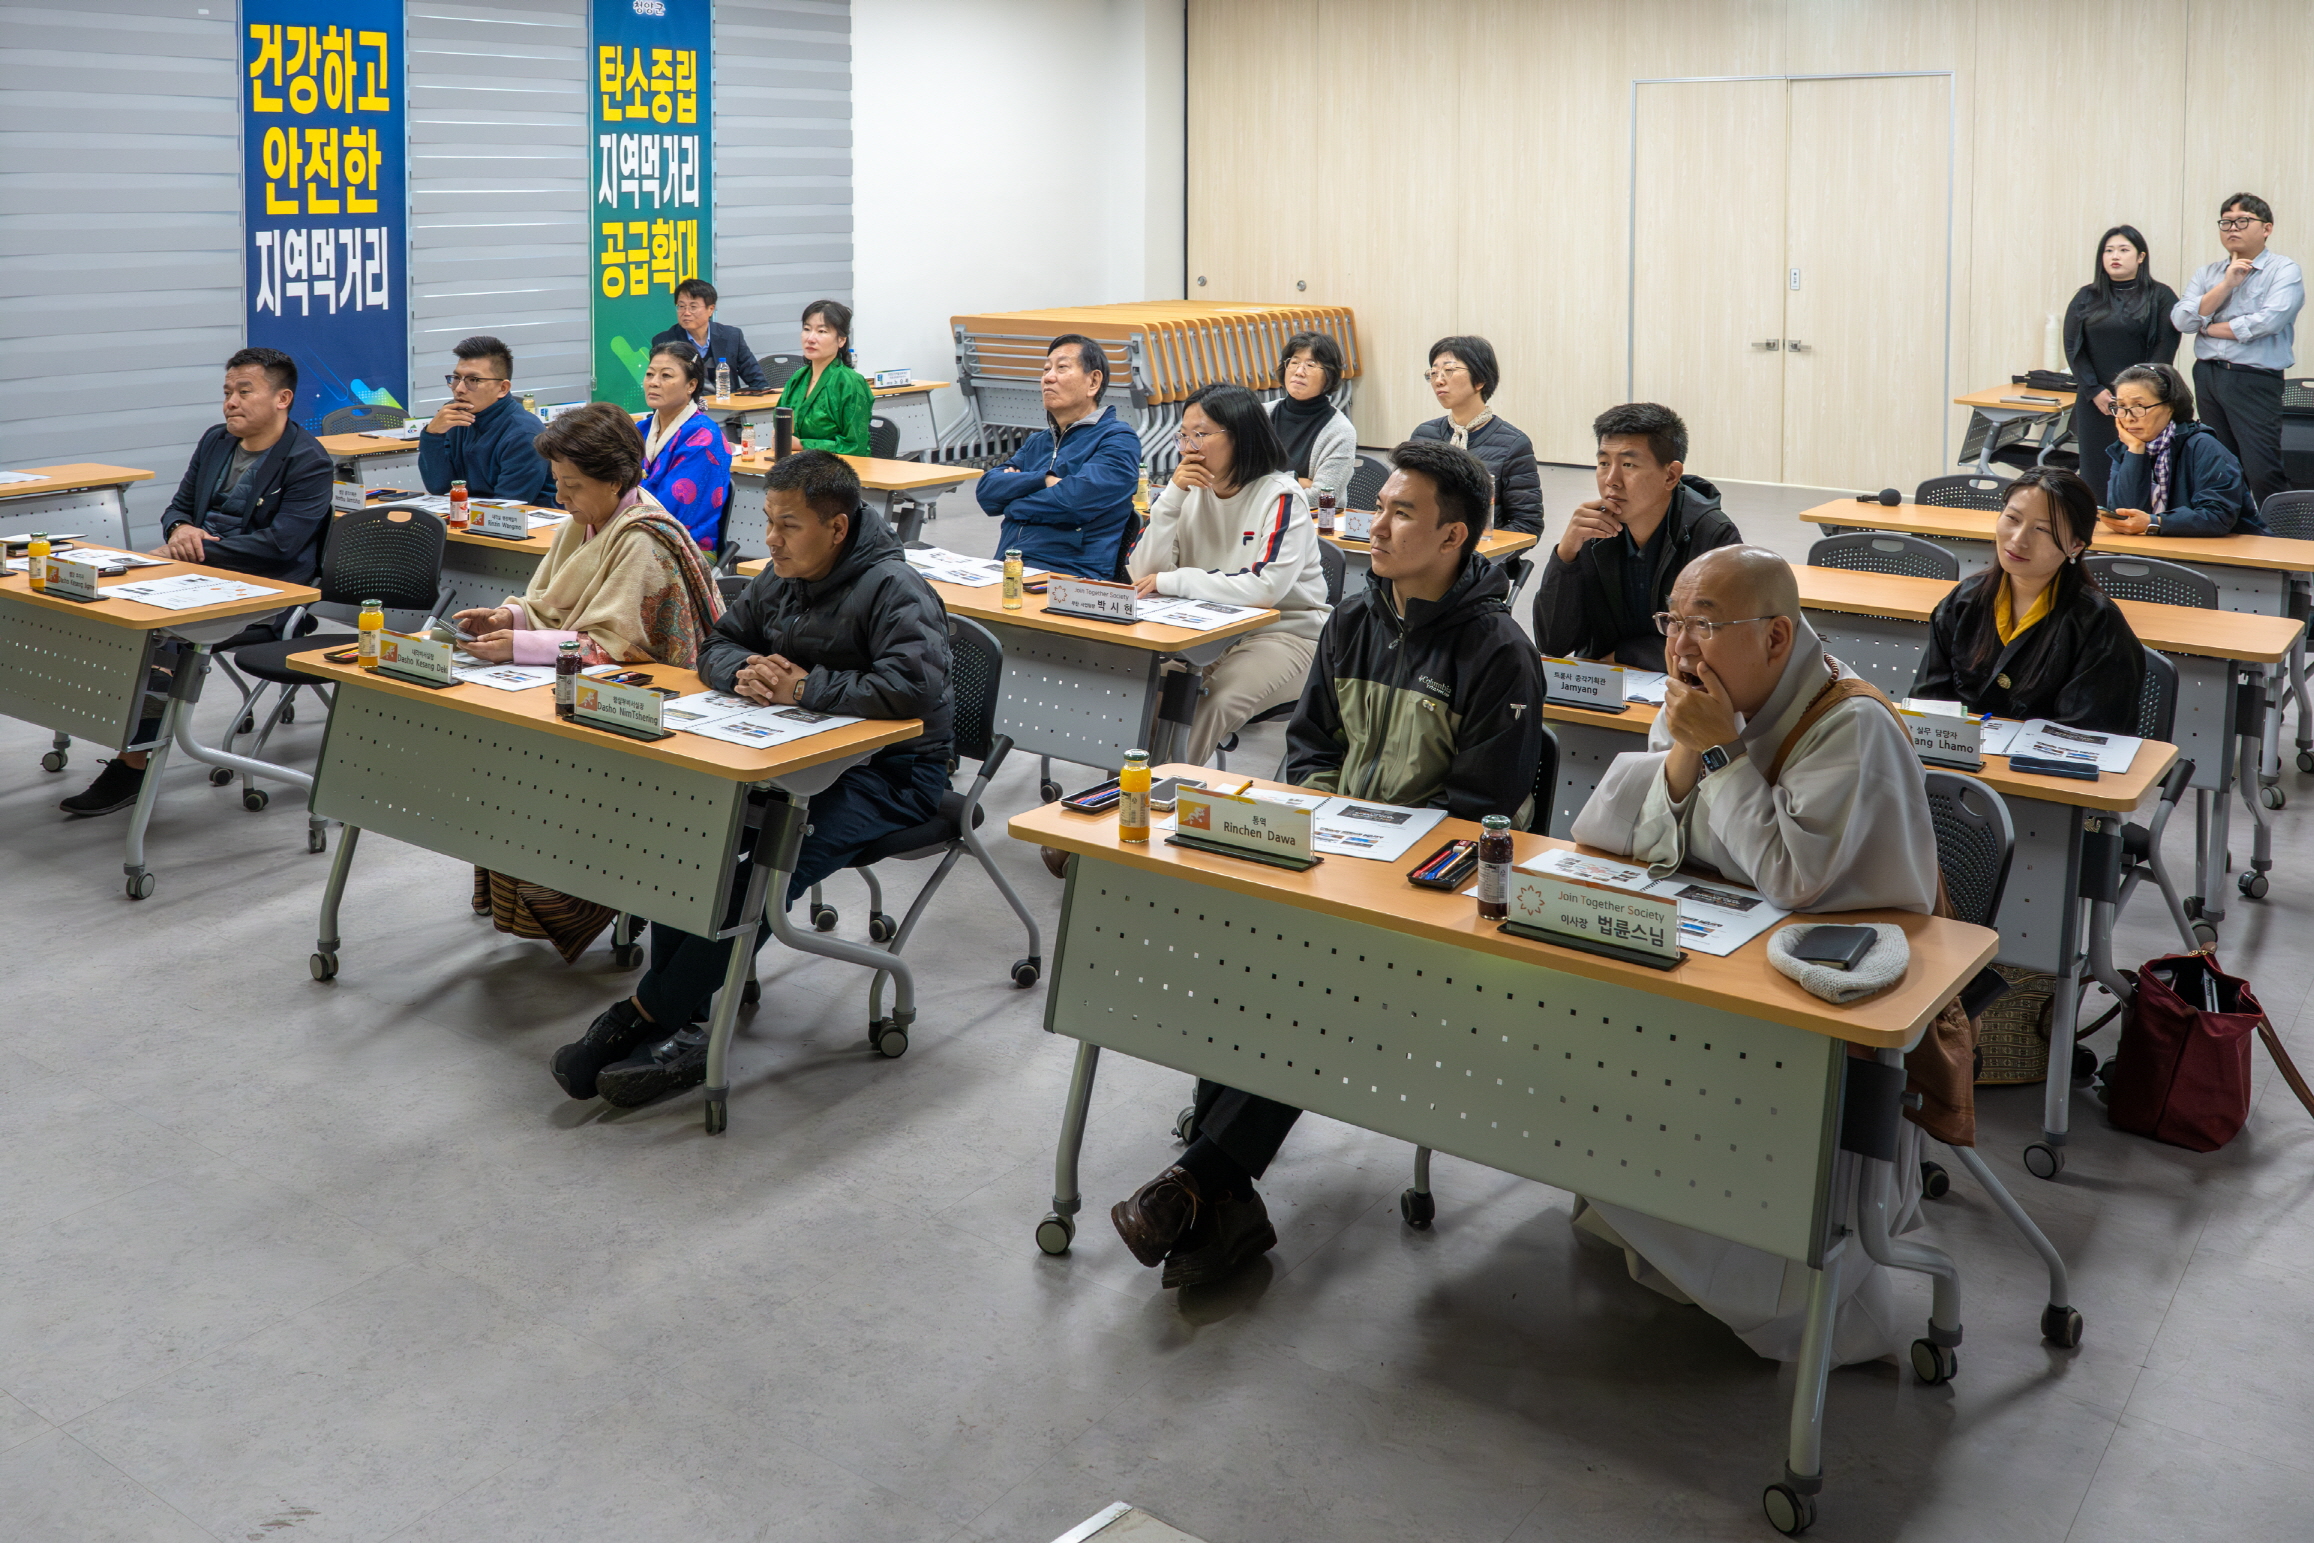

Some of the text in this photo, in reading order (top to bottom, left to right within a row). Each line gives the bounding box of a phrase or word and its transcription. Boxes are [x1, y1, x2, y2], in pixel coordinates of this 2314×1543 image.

[250, 24, 390, 114] 건강하고
[599, 45, 697, 124] 탄소중립
[263, 126, 382, 215] 안전한
[599, 133, 699, 209] 지역먹거리
[255, 226, 389, 317] 지역먹거리
[601, 218, 698, 298] 공급확대
[1086, 588, 1109, 597] Together
[1109, 592, 1130, 601] Society
[397, 653, 414, 665] Dasho
[415, 659, 435, 672] Kesang
[1560, 681, 1598, 696] Jamyang
[597, 701, 617, 714] Dasho
[1916, 726, 1932, 736] 실무
[1935, 728, 1958, 740] 담당자
[1938, 739, 1974, 754] Lhamo
[1223, 820, 1296, 846] Rinchen Dawa
[1252, 815, 1267, 827] 통역
[1558, 890, 1665, 924] Join Together Society
[1560, 913, 1665, 948] 이사장 법륜스님
